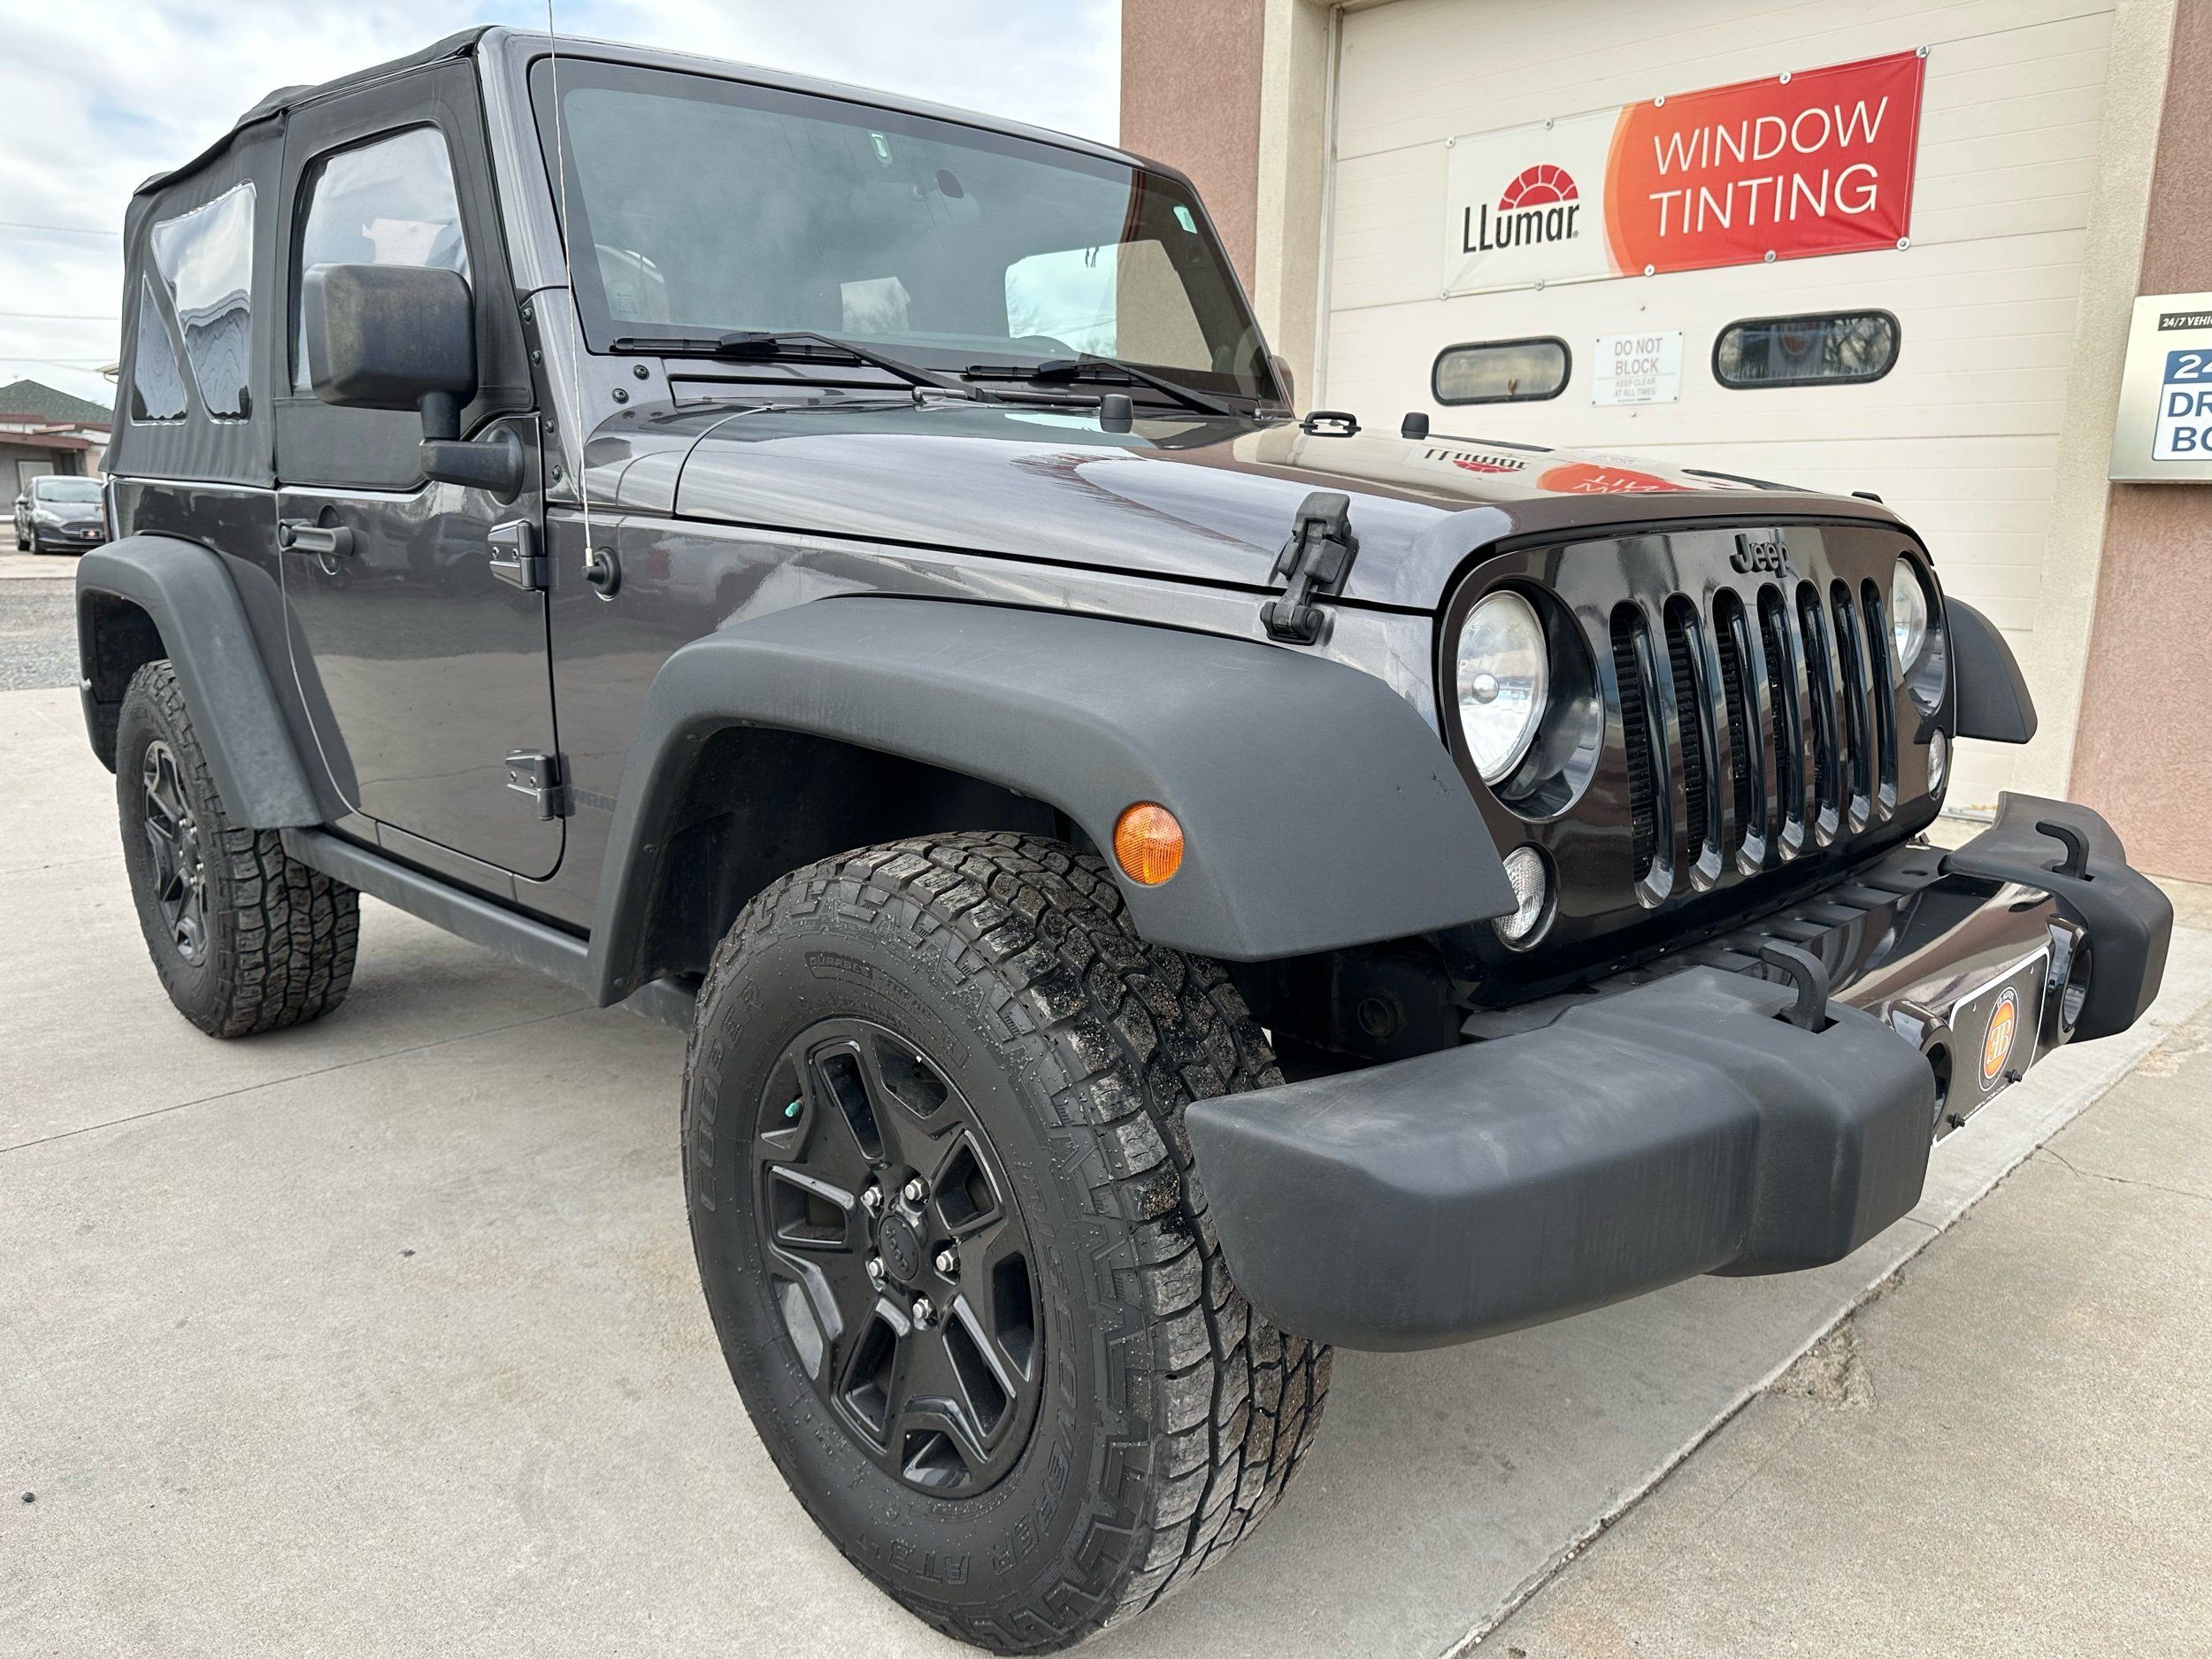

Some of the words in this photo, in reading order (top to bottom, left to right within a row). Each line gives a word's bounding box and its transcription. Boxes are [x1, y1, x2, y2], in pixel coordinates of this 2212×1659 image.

[1654, 96, 1888, 176] WINDOW
[1648, 163, 1878, 237] TINTING
[1463, 203, 1580, 254] LLumar
[2162, 317, 2186, 327] 24/7
[1615, 340, 1632, 356] DO
[1636, 337, 1663, 354] NOT
[1616, 357, 1658, 375] BLOCK
[1616, 379, 1632, 388] KEEP
[1633, 377, 1655, 387] CLEAR
[1637, 388, 1656, 396] TIMES
[1729, 534, 1789, 578] Jeep
